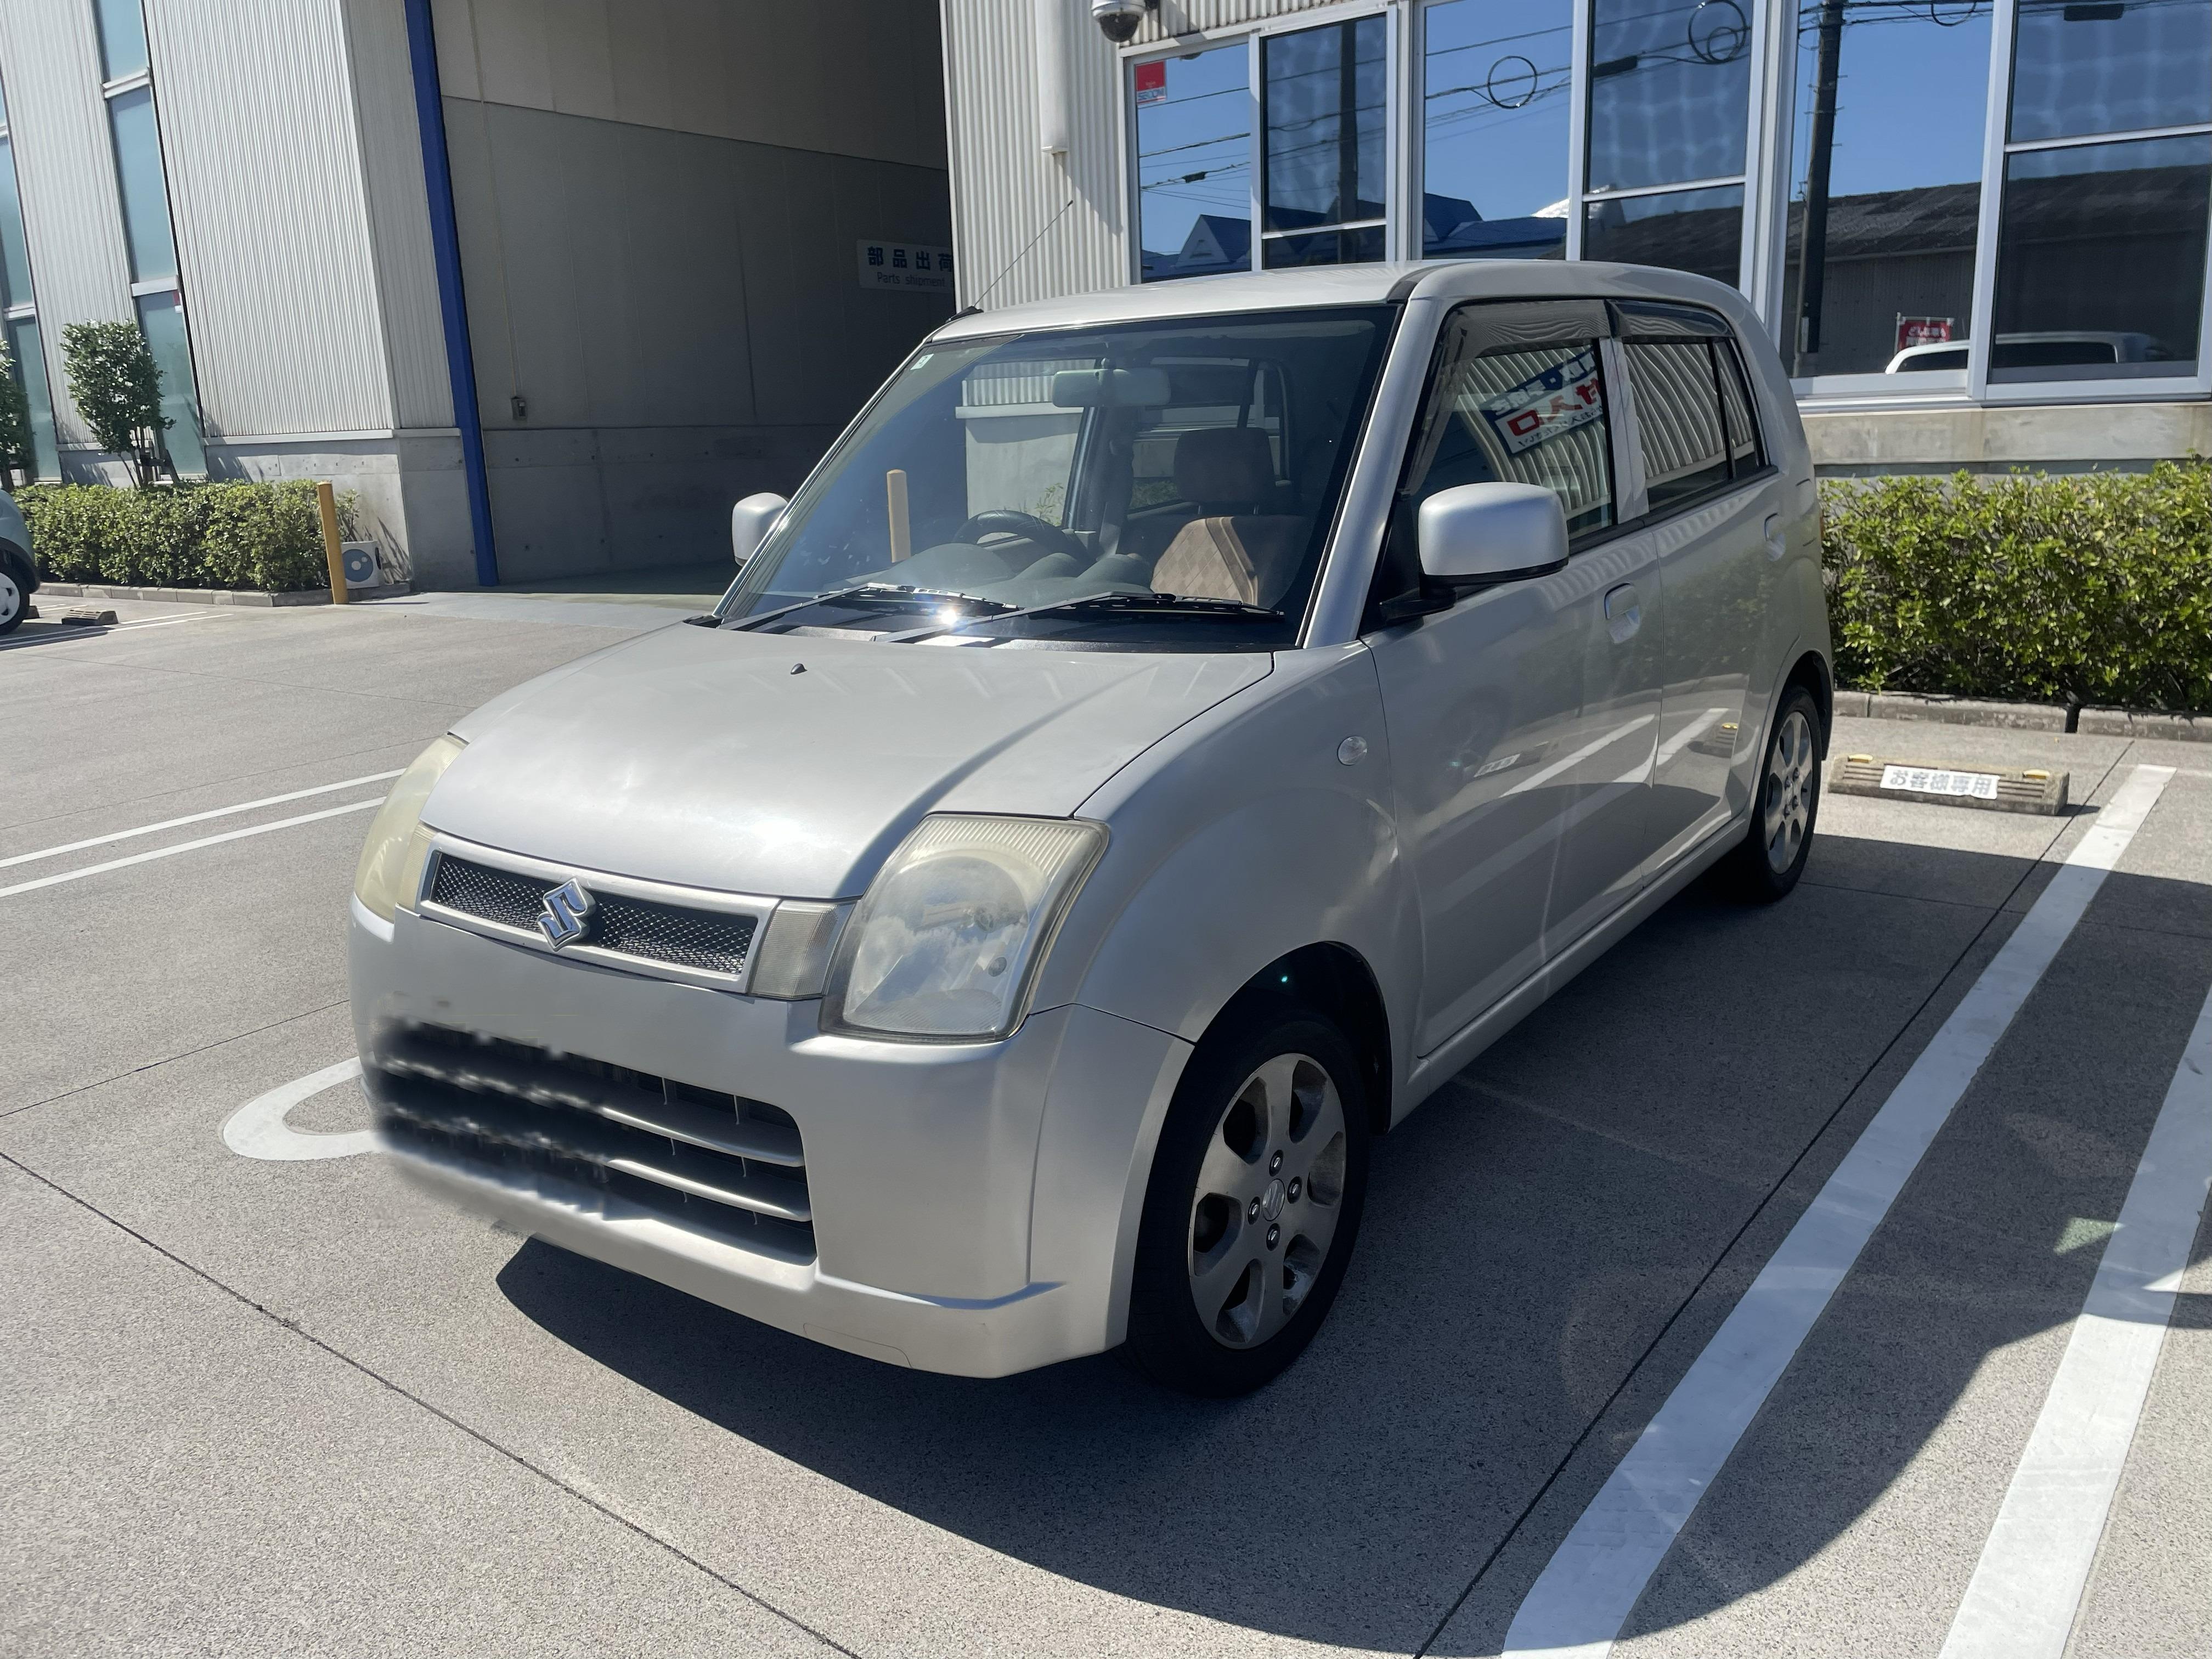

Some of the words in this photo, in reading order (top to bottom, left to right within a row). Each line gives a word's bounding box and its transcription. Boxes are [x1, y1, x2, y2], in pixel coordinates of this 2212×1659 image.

[868, 246, 953, 272] 部品出荷
[877, 272, 900, 284] Parts
[905, 274, 945, 288] shipment
[1889, 770, 1992, 795] お客様専用
